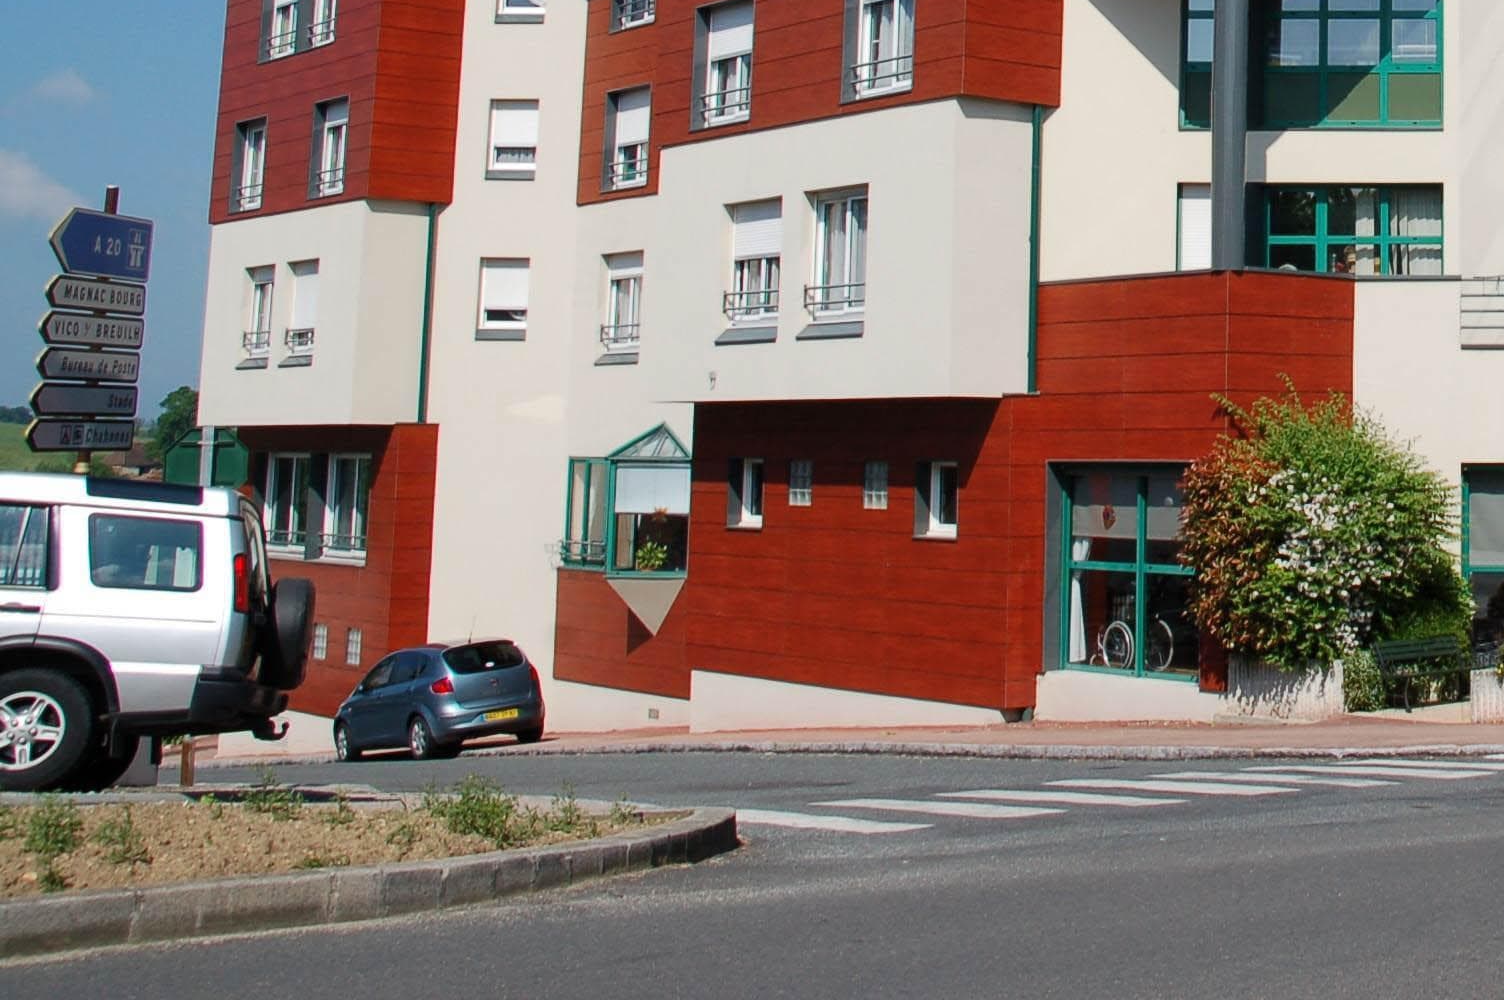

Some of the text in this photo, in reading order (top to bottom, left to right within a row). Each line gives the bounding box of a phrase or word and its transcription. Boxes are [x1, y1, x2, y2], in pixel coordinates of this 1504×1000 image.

[94, 234, 121, 256] A 20
[64, 283, 142, 307] MAGNAC BOURG
[96, 323, 140, 340] BREUILH
[61, 356, 136, 375] Bureau de Poste
[108, 393, 134, 409] Stade
